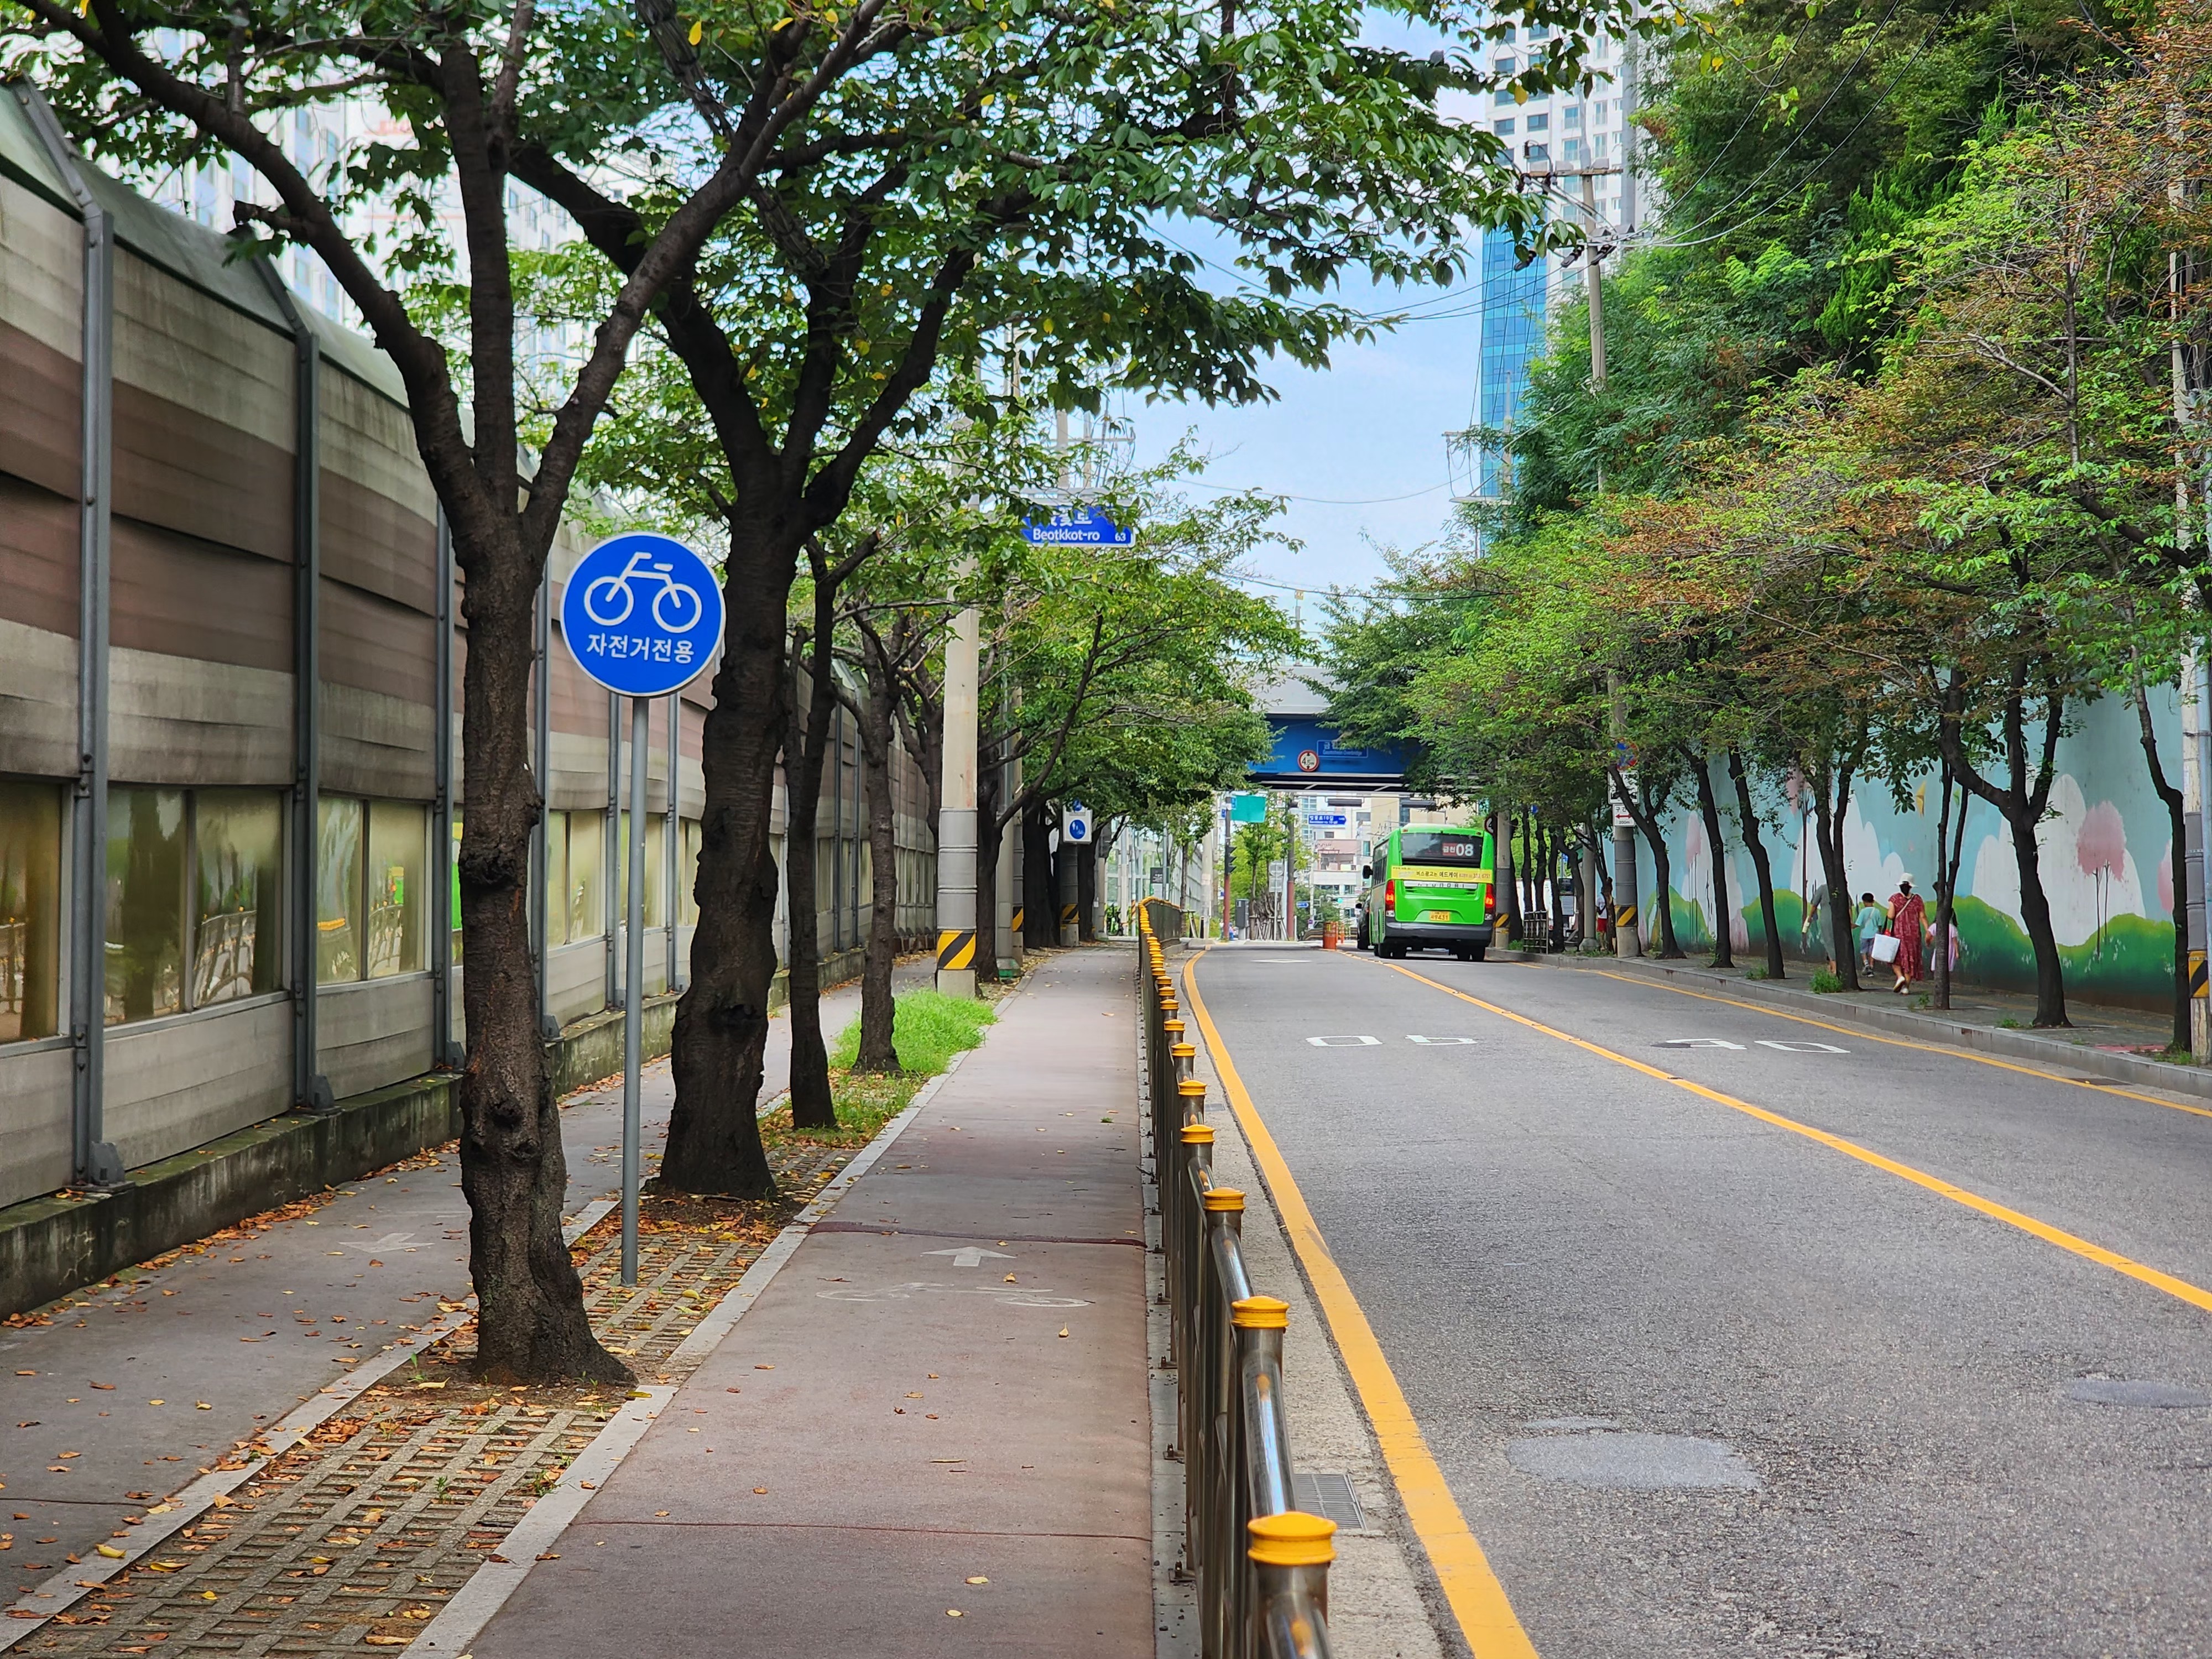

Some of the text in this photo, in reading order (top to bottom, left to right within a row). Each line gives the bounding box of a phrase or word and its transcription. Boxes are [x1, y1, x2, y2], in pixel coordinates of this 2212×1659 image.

[1033, 528, 1126, 541] Beotkkot-ro 63
[586, 633, 695, 664] 자전거전용
[1456, 843, 1474, 857] 08
